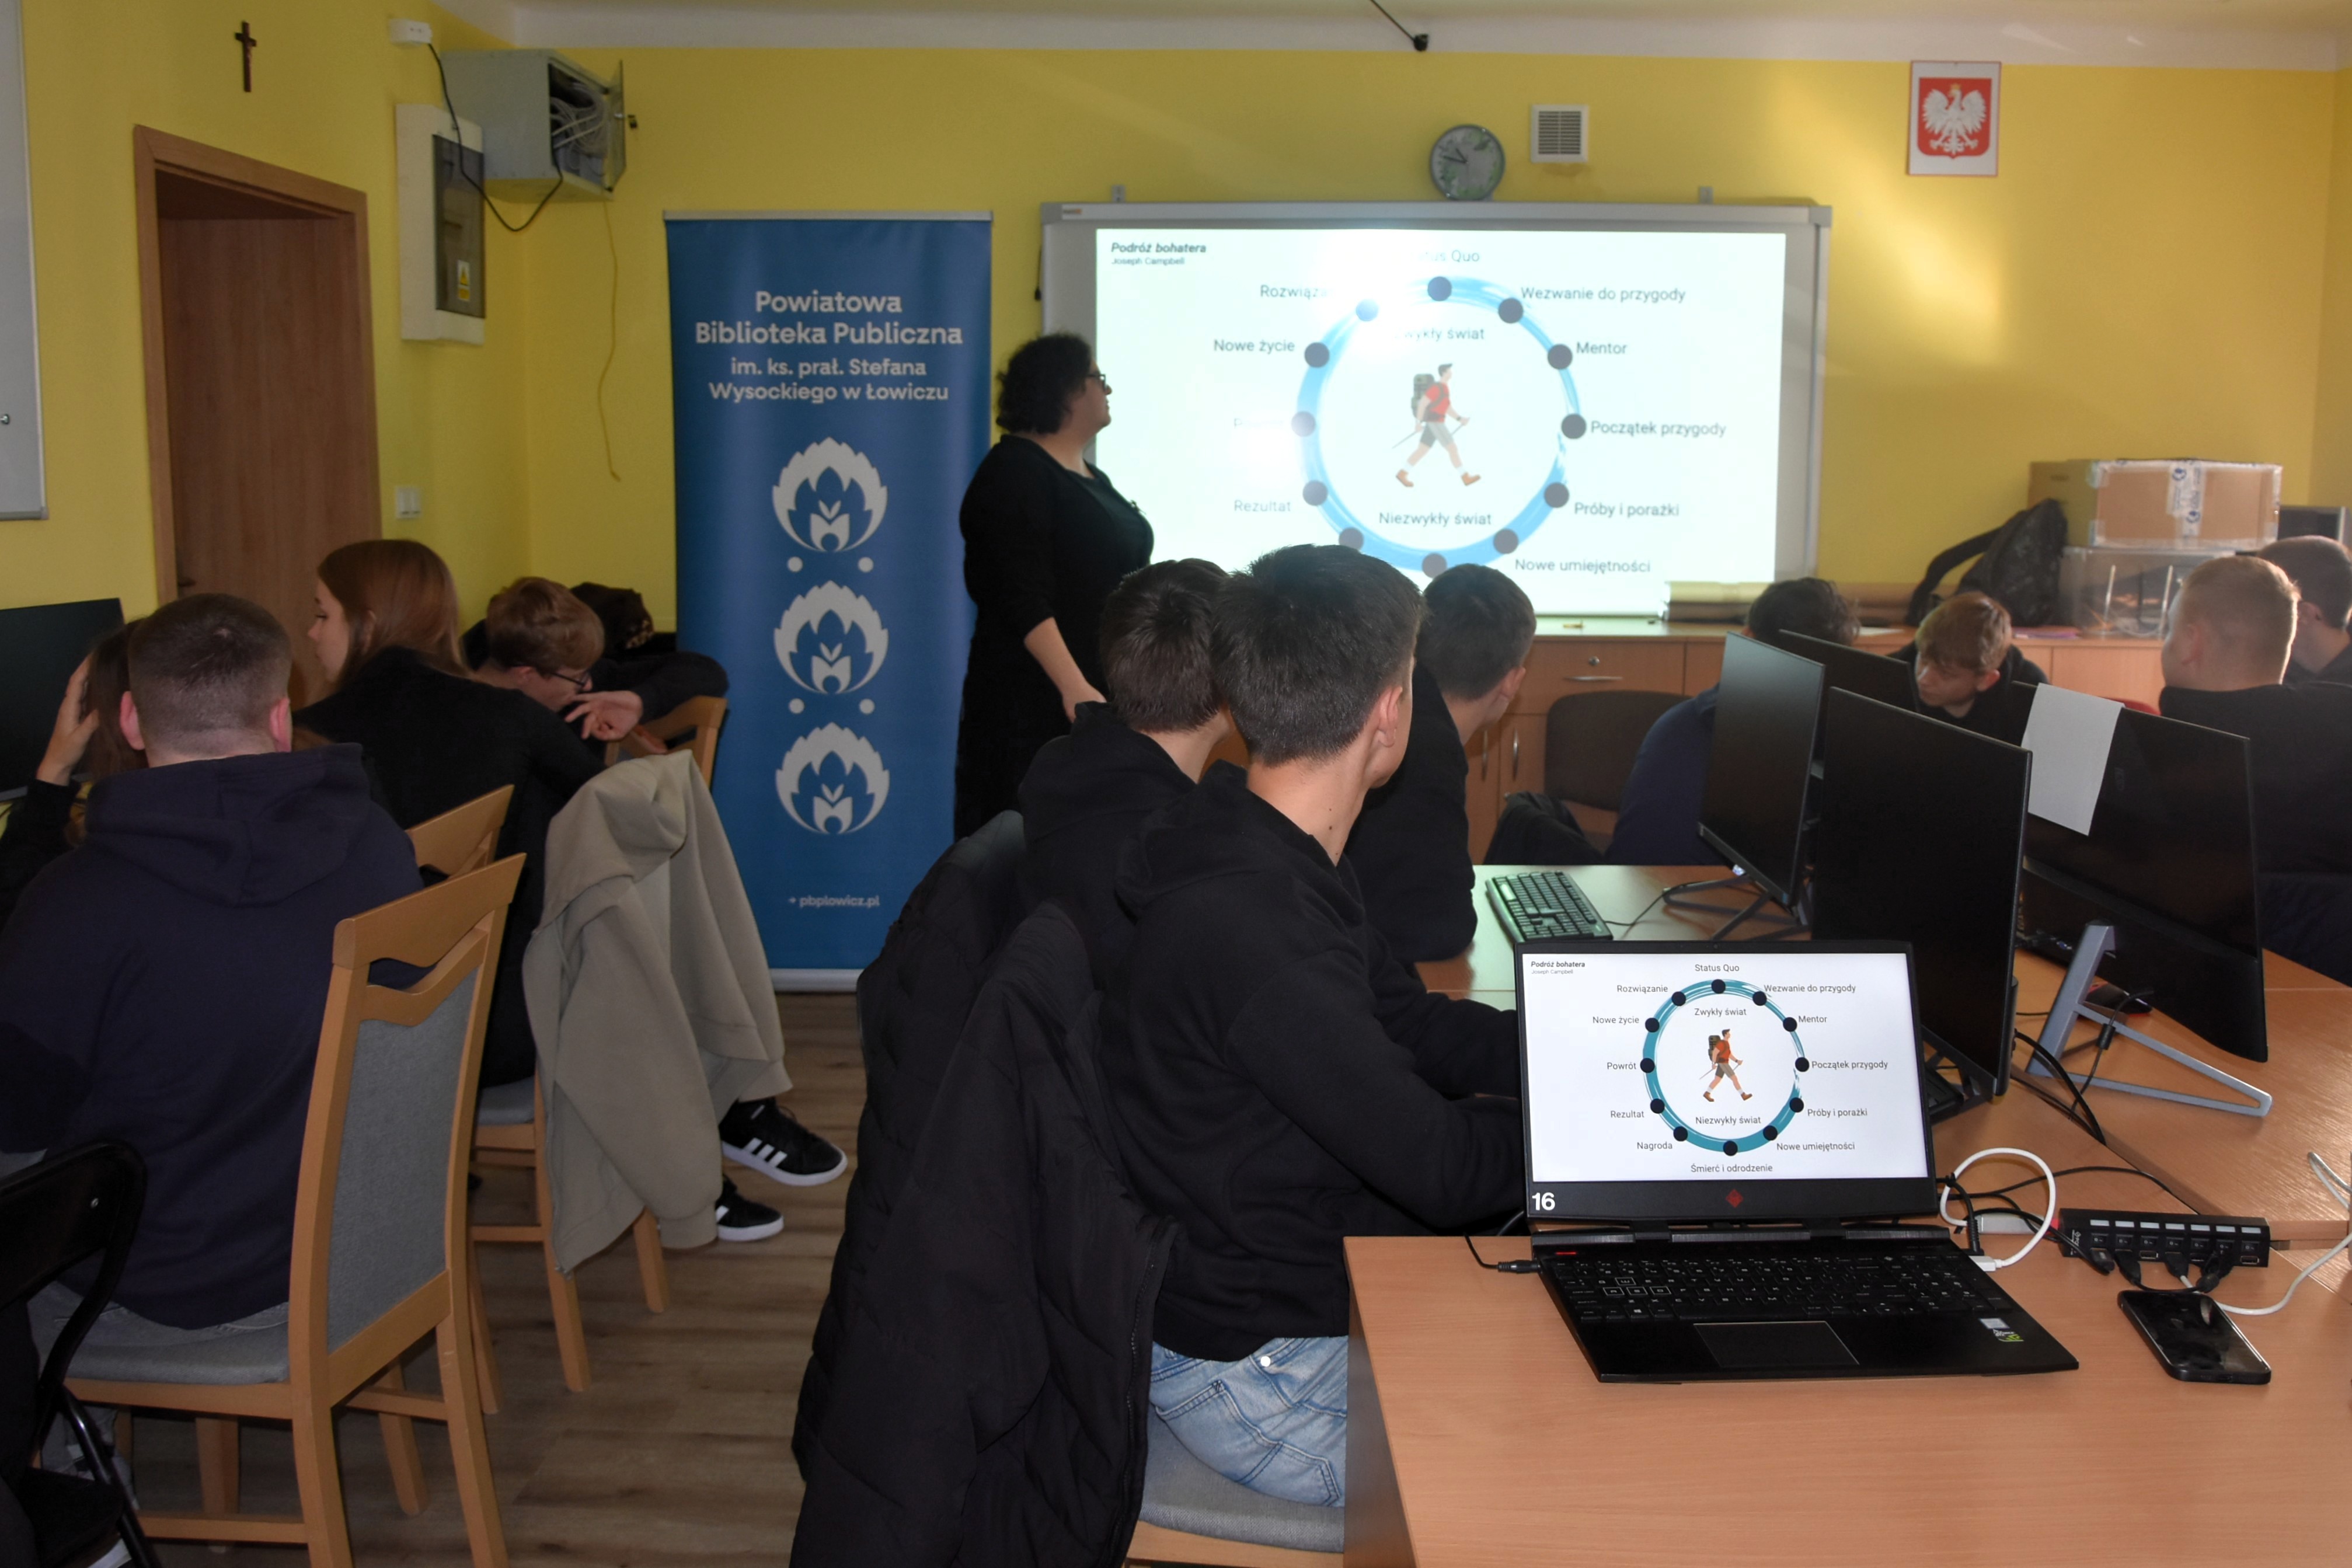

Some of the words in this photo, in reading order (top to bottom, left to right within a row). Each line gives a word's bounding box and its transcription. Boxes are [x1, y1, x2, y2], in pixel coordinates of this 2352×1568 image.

[1111, 242, 1152, 253] Podróż
[1155, 243, 1206, 253] bohatera
[1145, 257, 1184, 266] Campbell
[1452, 250, 1480, 263] Quo
[756, 290, 903, 313] Powiatowa
[1521, 287, 1593, 299] Wezwanie
[1598, 288, 1616, 300] do
[1621, 288, 1685, 304] przygody
[696, 320, 827, 344] Biblioteka
[834, 321, 963, 344] Publiczna
[1448, 329, 1484, 339] świat
[1214, 340, 1255, 351] Nowe
[1259, 340, 1295, 354] życie
[1577, 342, 1626, 354] Mentor
[731, 357, 762, 375] im.
[767, 358, 793, 375] ks.
[799, 358, 844, 378] prał.
[849, 358, 926, 375] Stefana
[709, 382, 837, 403] Wysockiego
[842, 387, 861, 399] w
[866, 382, 948, 400] Łowiczu
[1591, 420, 1656, 437] Początek
[1661, 423, 1726, 438] przygody
[1234, 500, 1290, 512] Rezultat
[1574, 502, 1615, 518] Próby
[1619, 503, 1623, 515] i
[1627, 504, 1679, 518] porażki
[1379, 513, 1449, 527] Niezwykły
[1455, 513, 1491, 525] świat
[1515, 559, 1555, 570] Nowe
[1560, 560, 1650, 574] umiejętności
[800, 895, 880, 908] pbplowicz.pl
[1695, 964, 1720, 972] Status
[1617, 985, 1668, 994] Rozwiązanie
[1820, 984, 1856, 993] przygody
[1695, 1008, 1722, 1017] Zwykły
[1619, 1016, 1639, 1025] życie
[1812, 1061, 1849, 1070] Początek
[1852, 1060, 1888, 1069] przygody
[1807, 1109, 1831, 1118] Próby
[1838, 1109, 1867, 1117] porażki
[1696, 1116, 1736, 1126] Niezwykły
[1637, 1141, 1672, 1151] Nagroda
[1803, 1142, 1855, 1152] umiejętności
[1691, 1163, 1720, 1172] Śmierć
[1532, 1192, 1555, 1210] 16
